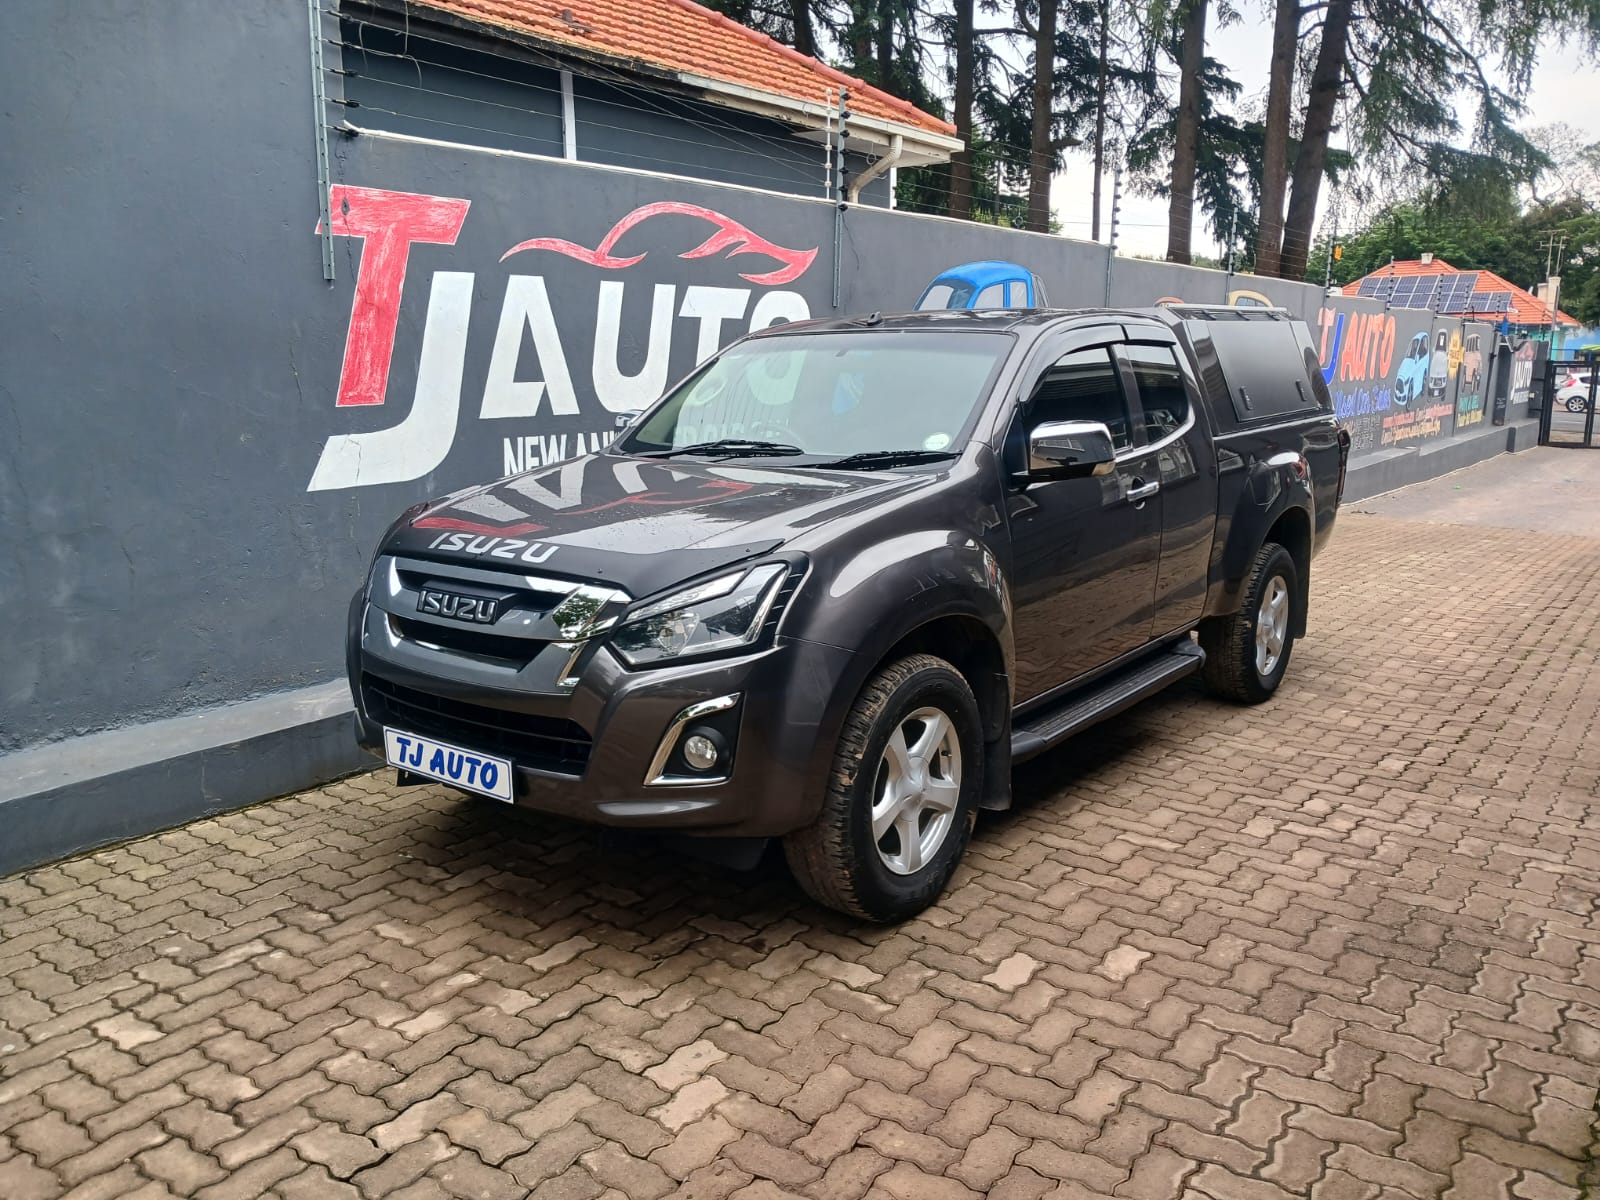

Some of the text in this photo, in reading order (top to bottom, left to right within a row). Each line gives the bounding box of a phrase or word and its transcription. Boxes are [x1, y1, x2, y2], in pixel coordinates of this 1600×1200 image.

[307, 184, 475, 491] TJ
[1318, 307, 1344, 386] TJ
[1340, 310, 1395, 381] AUTO
[503, 434, 567, 476] NEW
[428, 532, 560, 563] ISUZU
[419, 589, 498, 623] ISUZU
[396, 737, 498, 790] TJ AUTO
